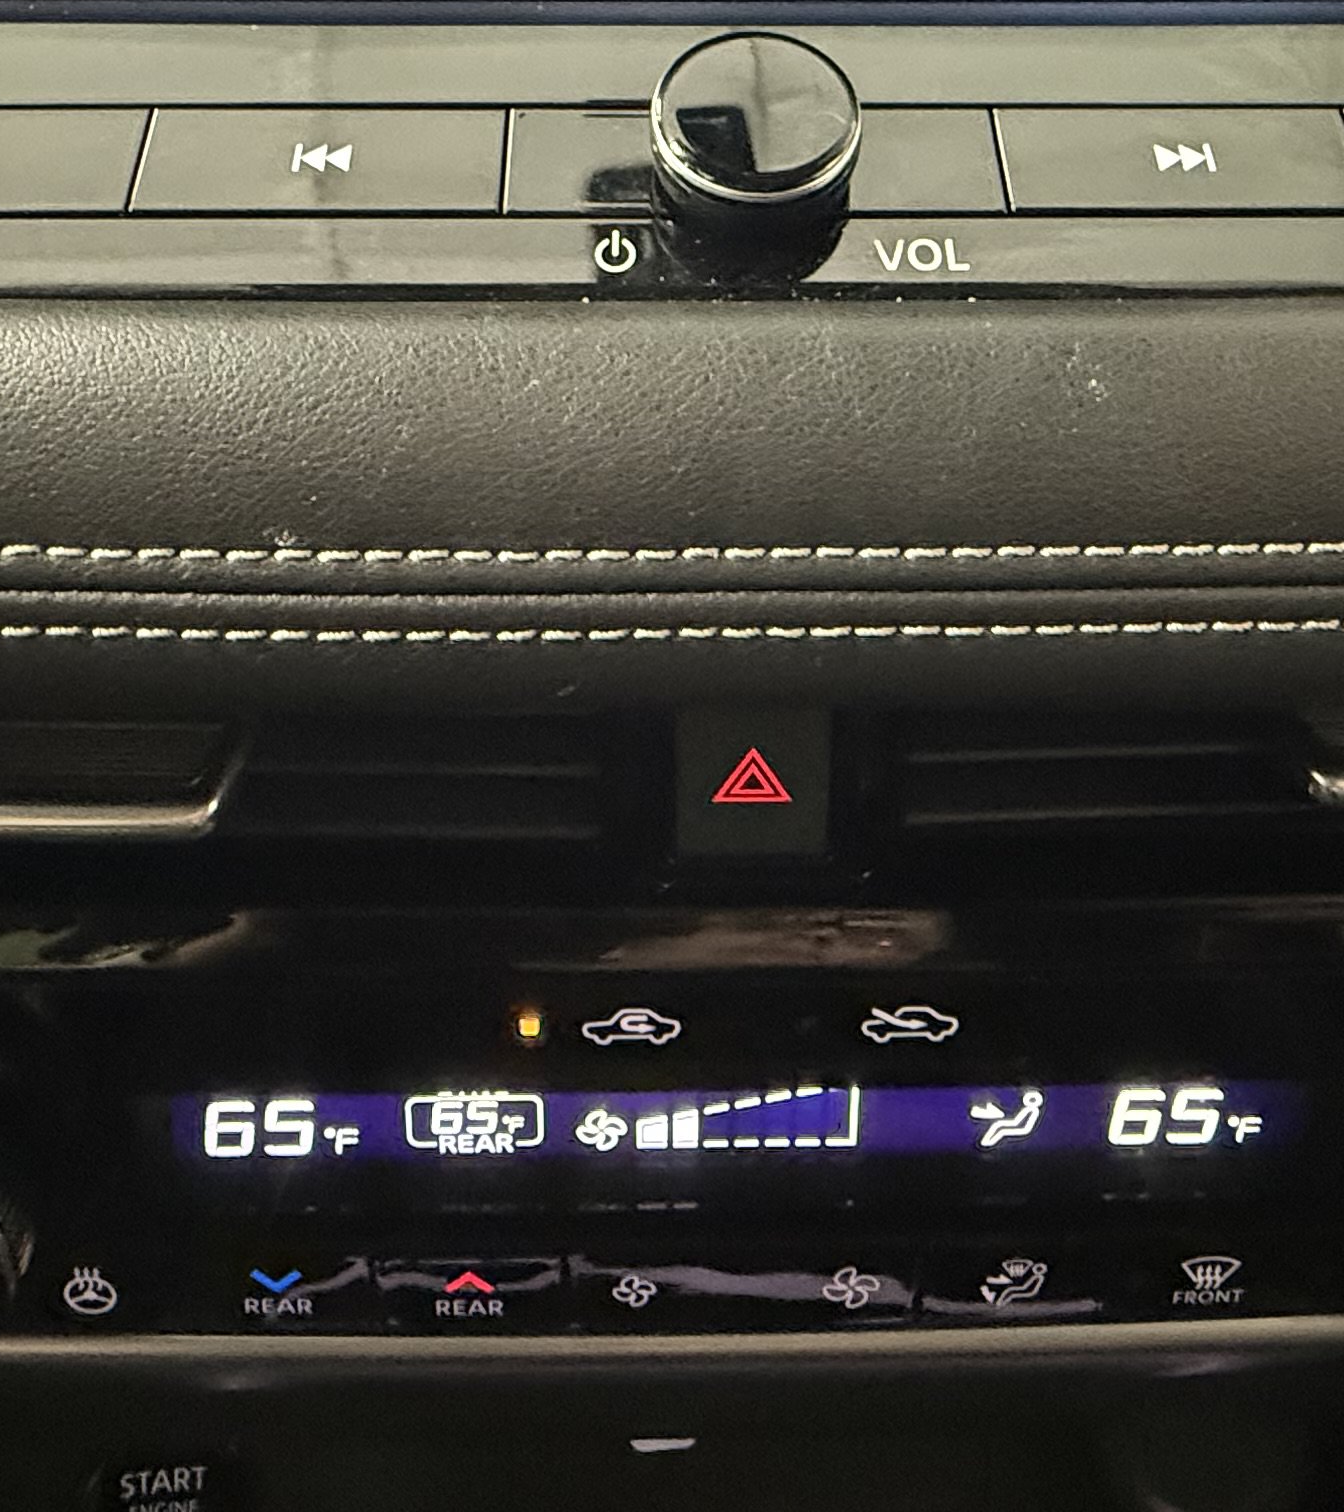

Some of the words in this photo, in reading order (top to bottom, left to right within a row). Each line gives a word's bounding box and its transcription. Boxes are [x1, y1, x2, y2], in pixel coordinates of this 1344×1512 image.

[873, 238, 971, 273] VOL
[438, 1133, 515, 1155] REAR
[244, 1297, 313, 1315] REAR
[1172, 1289, 1244, 1306] FRONT
[435, 1299, 504, 1317] REAR
[119, 1467, 208, 1500] START
